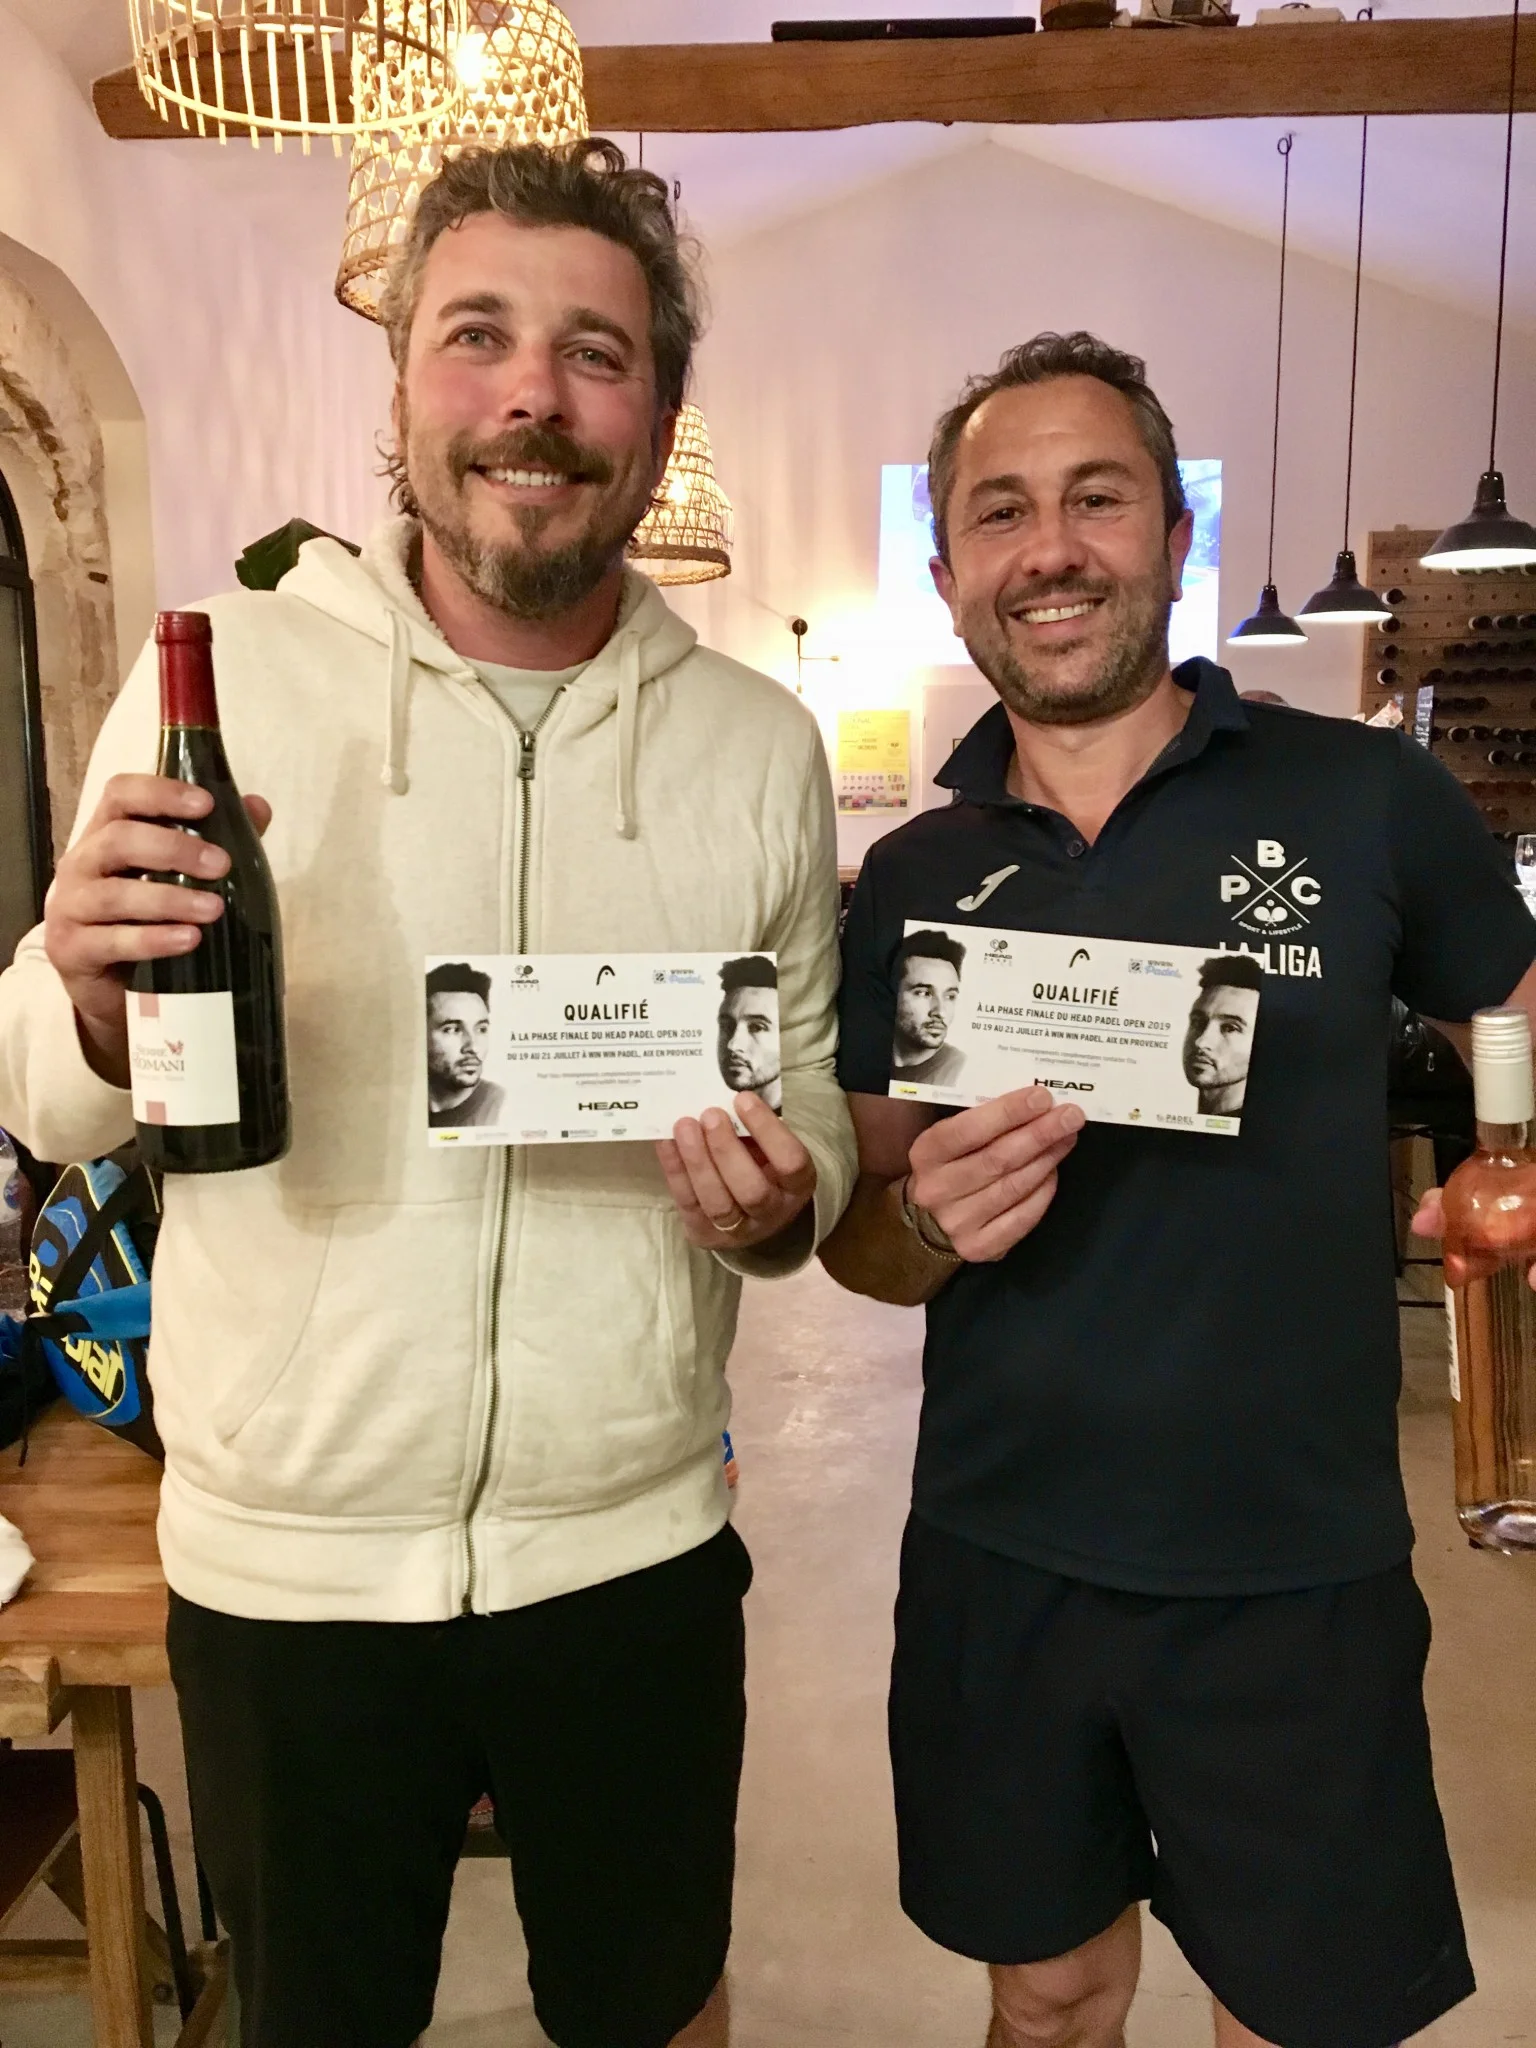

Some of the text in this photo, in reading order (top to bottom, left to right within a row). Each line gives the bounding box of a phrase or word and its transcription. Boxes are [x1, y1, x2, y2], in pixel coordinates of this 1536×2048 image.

[1257, 839, 1286, 868] B
[1220, 875, 1322, 906] P C
[1238, 920, 1261, 933] SPORT
[1268, 923, 1303, 936] LIFESTYLE
[1264, 943, 1323, 979] LIGA
[1032, 982, 1119, 1006] QUALIFIÉ
[564, 998, 649, 1021] QUALIFIÉ
[984, 1005, 995, 1013] LA
[997, 1006, 1024, 1017] PHASE
[1026, 1009, 1055, 1020] FINALE
[1056, 1012, 1068, 1021] DU
[1070, 1013, 1092, 1023] HEAD
[1094, 1016, 1120, 1026] PADEL
[1123, 1018, 1145, 1028] OPEN
[1147, 1021, 1171, 1031] 2019
[518, 1032, 529, 1041] LA
[531, 1032, 558, 1041] PHASE
[560, 1031, 589, 1040] FINALE
[591, 1031, 603, 1040] DU
[605, 1030, 627, 1039] HEAD
[629, 1030, 655, 1039] PADEL
[656, 1029, 678, 1038] OPEN
[680, 1029, 703, 1038] 2019
[971, 1022, 982, 1030] DU
[983, 1023, 992, 1031] 19
[1004, 1026, 1014, 1034] 21
[1015, 1027, 1044, 1036] JUILLET
[1051, 1031, 1064, 1039] WIN
[1065, 1032, 1079, 1040] WIN
[1106, 1036, 1117, 1044] AIX
[1119, 1037, 1129, 1045] EN
[1130, 1039, 1168, 1049] PROVENCE
[133, 1056, 185, 1072] OMANI
[507, 1052, 517, 1060] DU
[519, 1052, 529, 1060] 19
[530, 1052, 540, 1060] AU
[541, 1052, 551, 1060] 21
[553, 1051, 580, 1060] JUILLET
[588, 1051, 601, 1059] WIN
[656, 1049, 665, 1057] EN
[666, 1048, 703, 1057] PROVENCE
[1034, 1077, 1095, 1092] HEAD
[577, 1101, 639, 1111] HEAD
